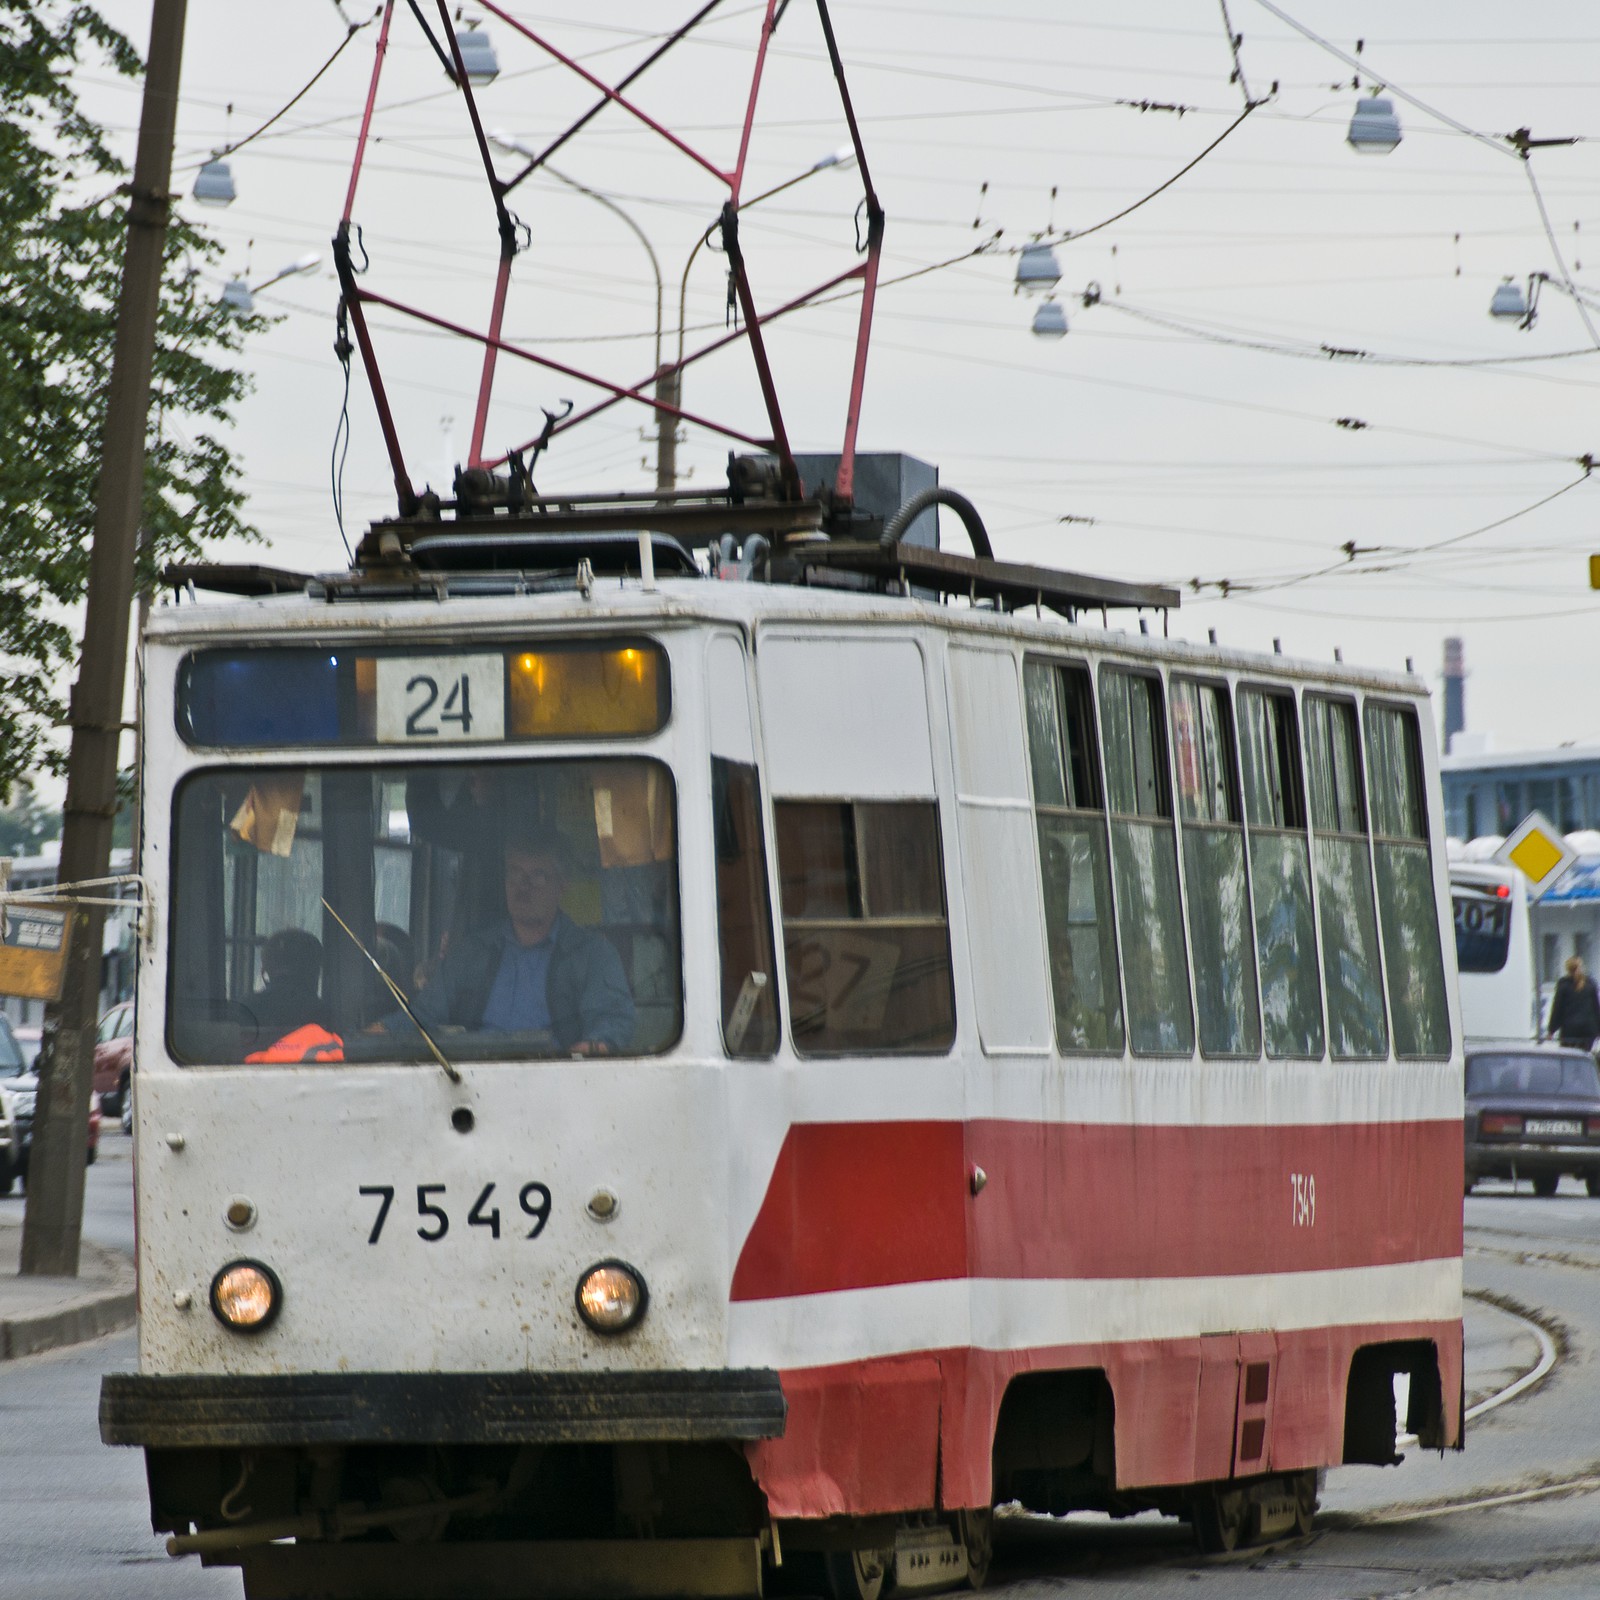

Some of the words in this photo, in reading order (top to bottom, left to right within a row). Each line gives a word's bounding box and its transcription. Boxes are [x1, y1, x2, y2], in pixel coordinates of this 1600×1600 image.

[405, 673, 473, 736] 24
[358, 1181, 552, 1244] 7549
[1290, 1173, 1316, 1227] 7549
